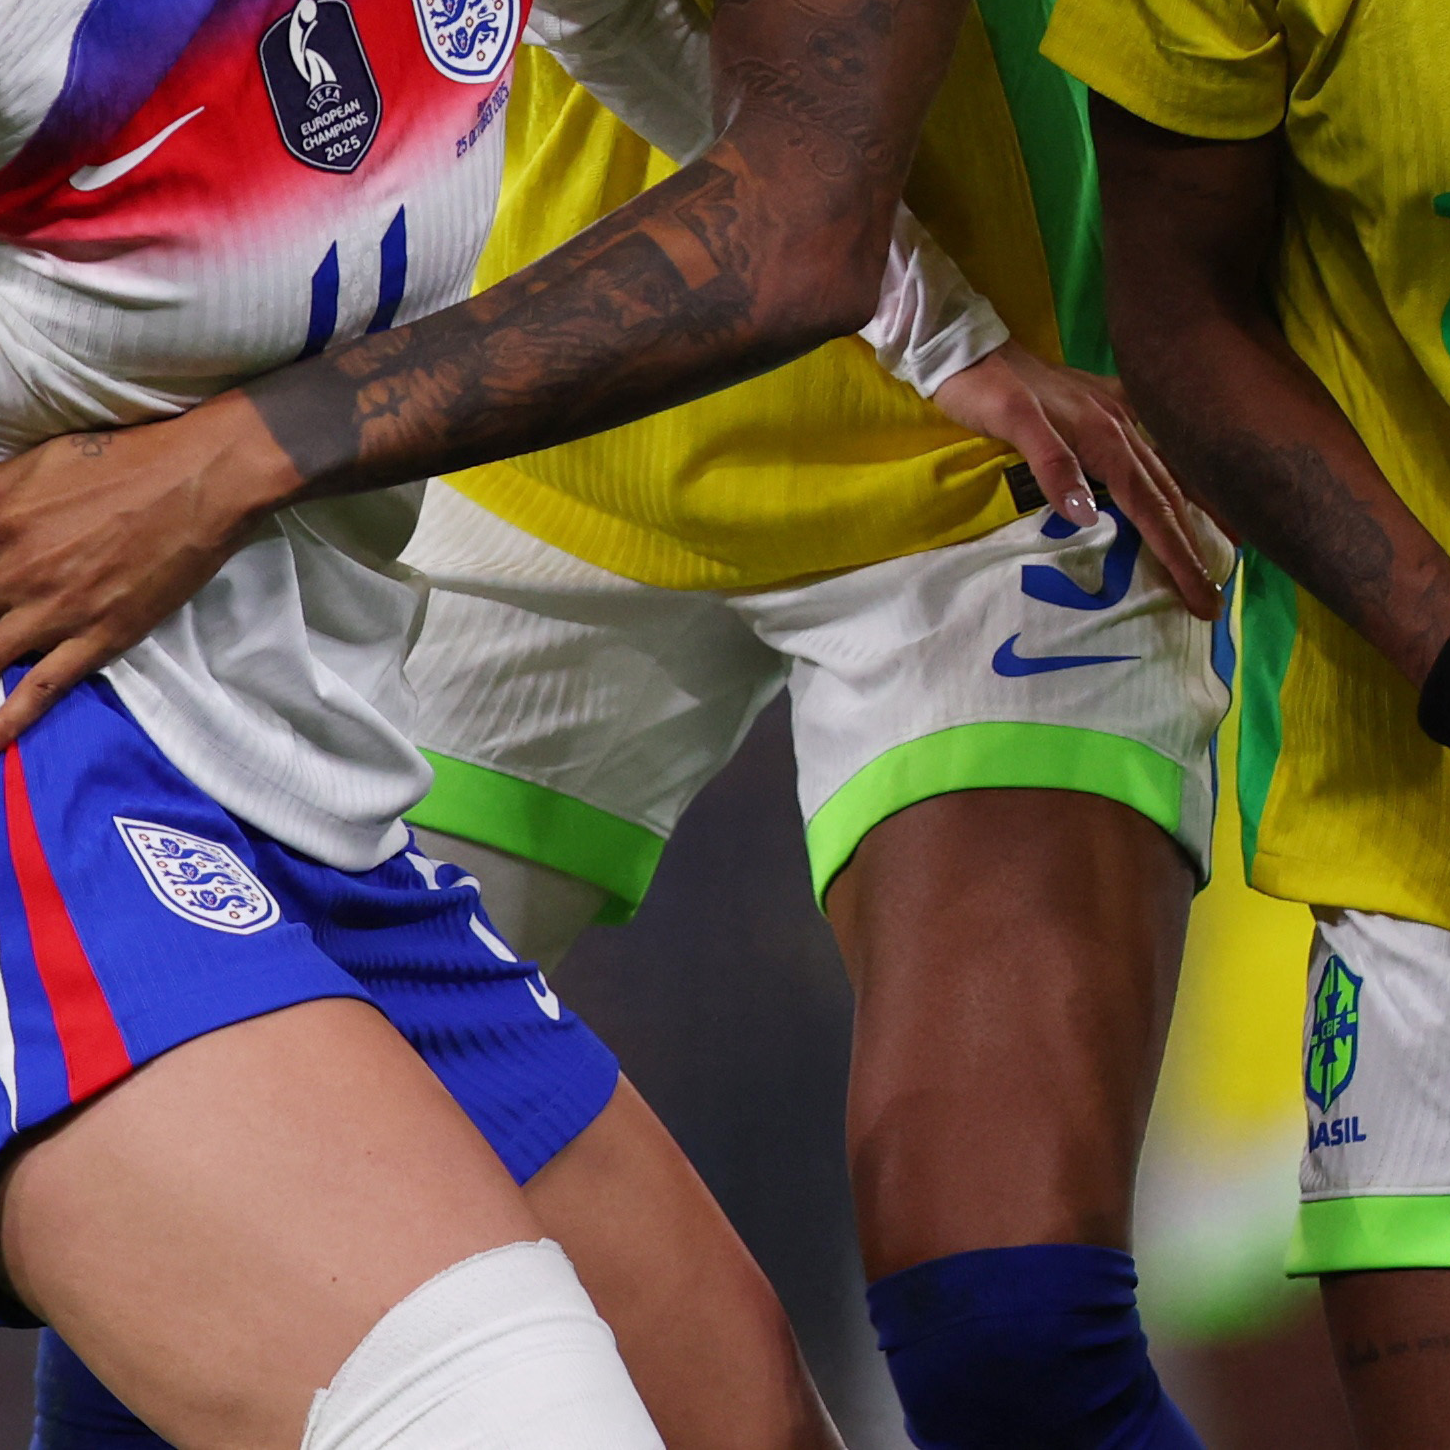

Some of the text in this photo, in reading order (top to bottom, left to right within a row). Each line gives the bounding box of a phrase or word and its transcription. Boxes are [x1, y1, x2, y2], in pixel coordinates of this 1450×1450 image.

[300, 98, 361, 136] EUROPEAN
[309, 87, 341, 110] UEFA
[302, 111, 369, 151] CHAMPIONS
[324, 134, 361, 162] 2025
[293, 203, 408, 363] 11
[1320, 1016, 1342, 1039] CBF
[1308, 1115, 1367, 1153] ASIL
